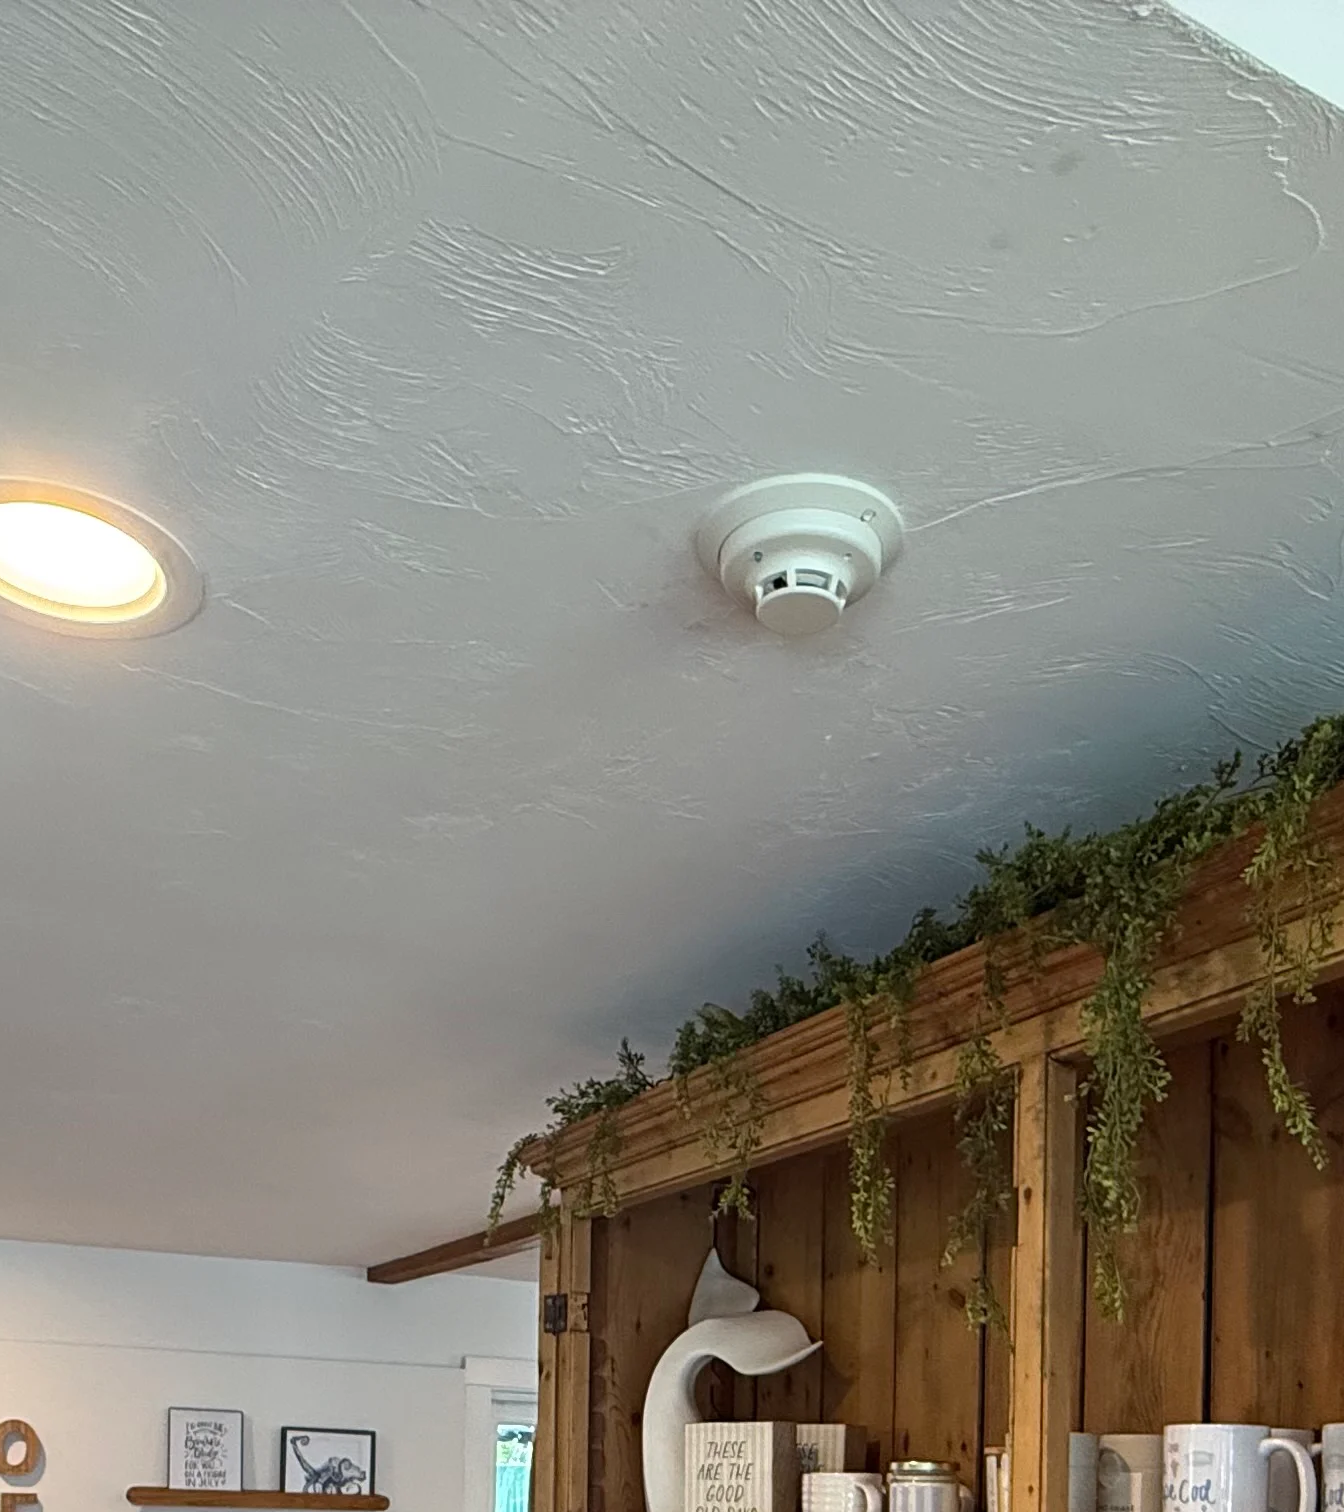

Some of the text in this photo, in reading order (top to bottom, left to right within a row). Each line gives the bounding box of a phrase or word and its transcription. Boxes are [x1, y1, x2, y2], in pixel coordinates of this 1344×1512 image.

[705, 1440, 747, 1460] THESE
[696, 1462, 755, 1482] ARE THE
[705, 1484, 745, 1504] GOOD
[1177, 1479, 1216, 1505] Cod
